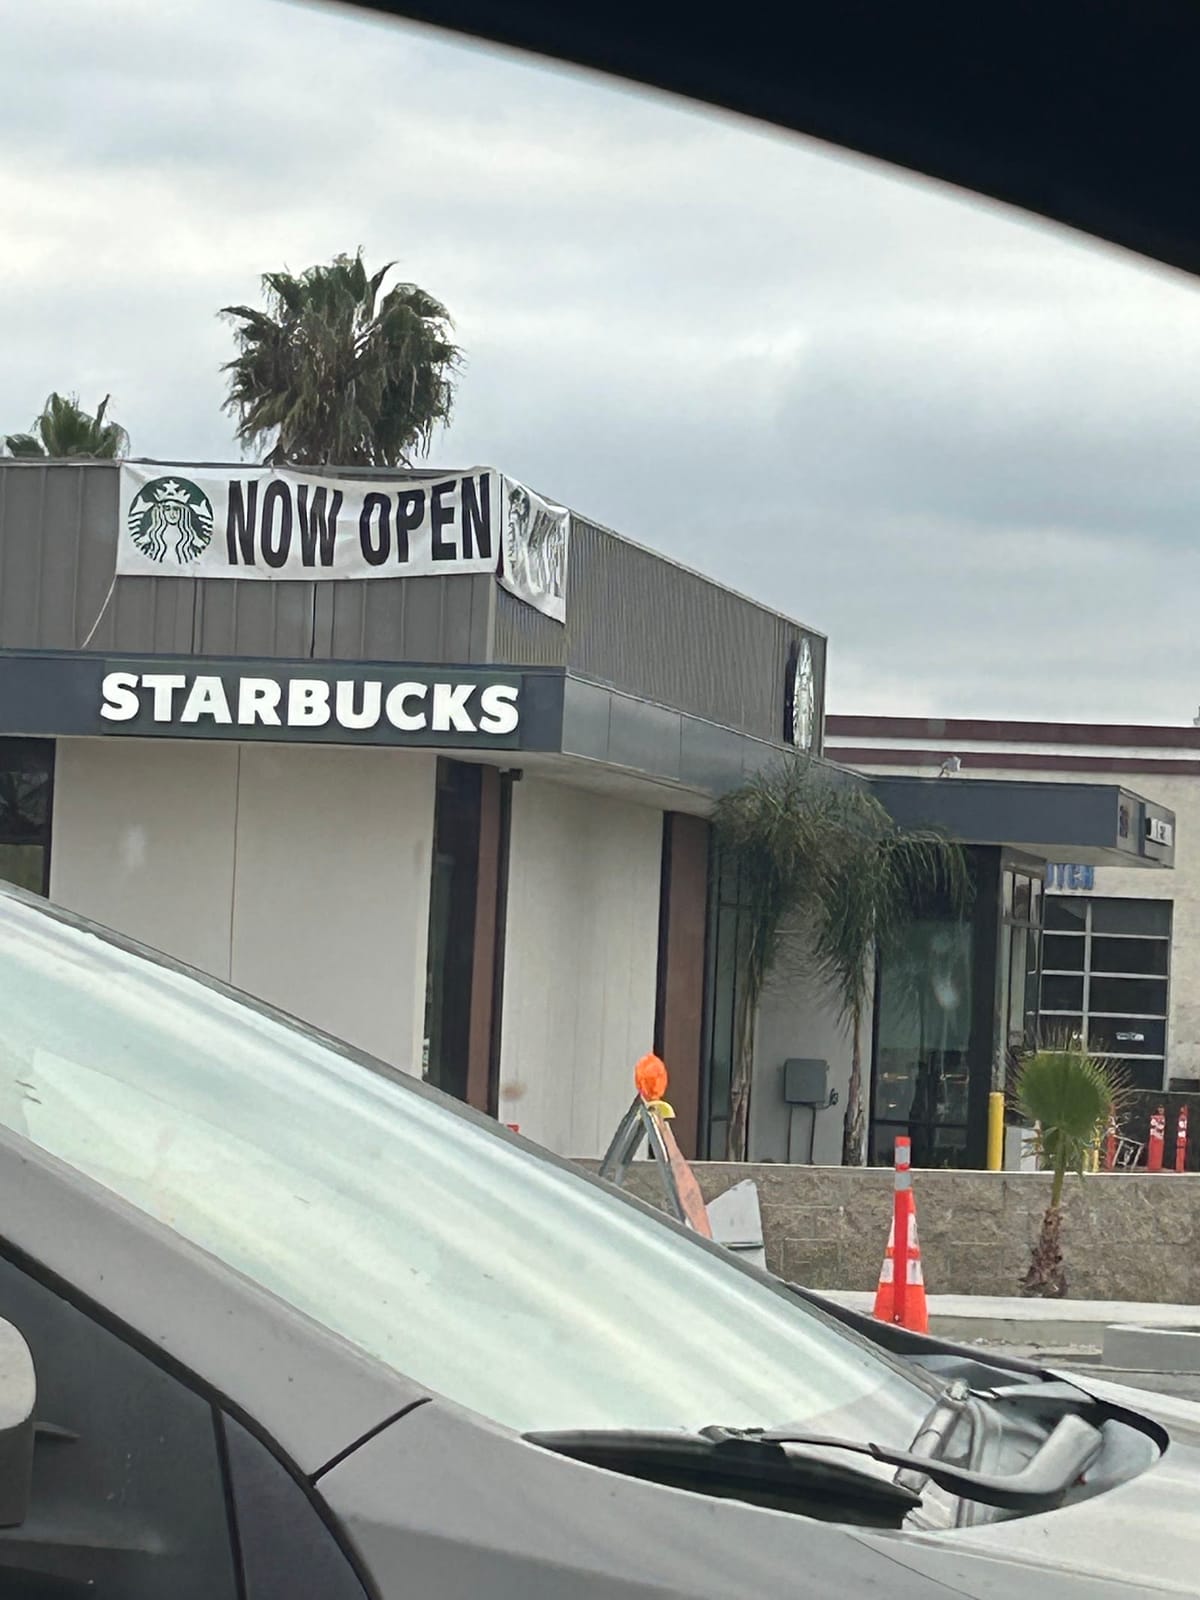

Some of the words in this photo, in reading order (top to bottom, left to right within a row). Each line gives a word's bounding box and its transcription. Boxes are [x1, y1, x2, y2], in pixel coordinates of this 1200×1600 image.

[226, 478, 342, 568] NOW
[359, 473, 492, 566] OPEN
[100, 672, 520, 735] STARBUCKS
